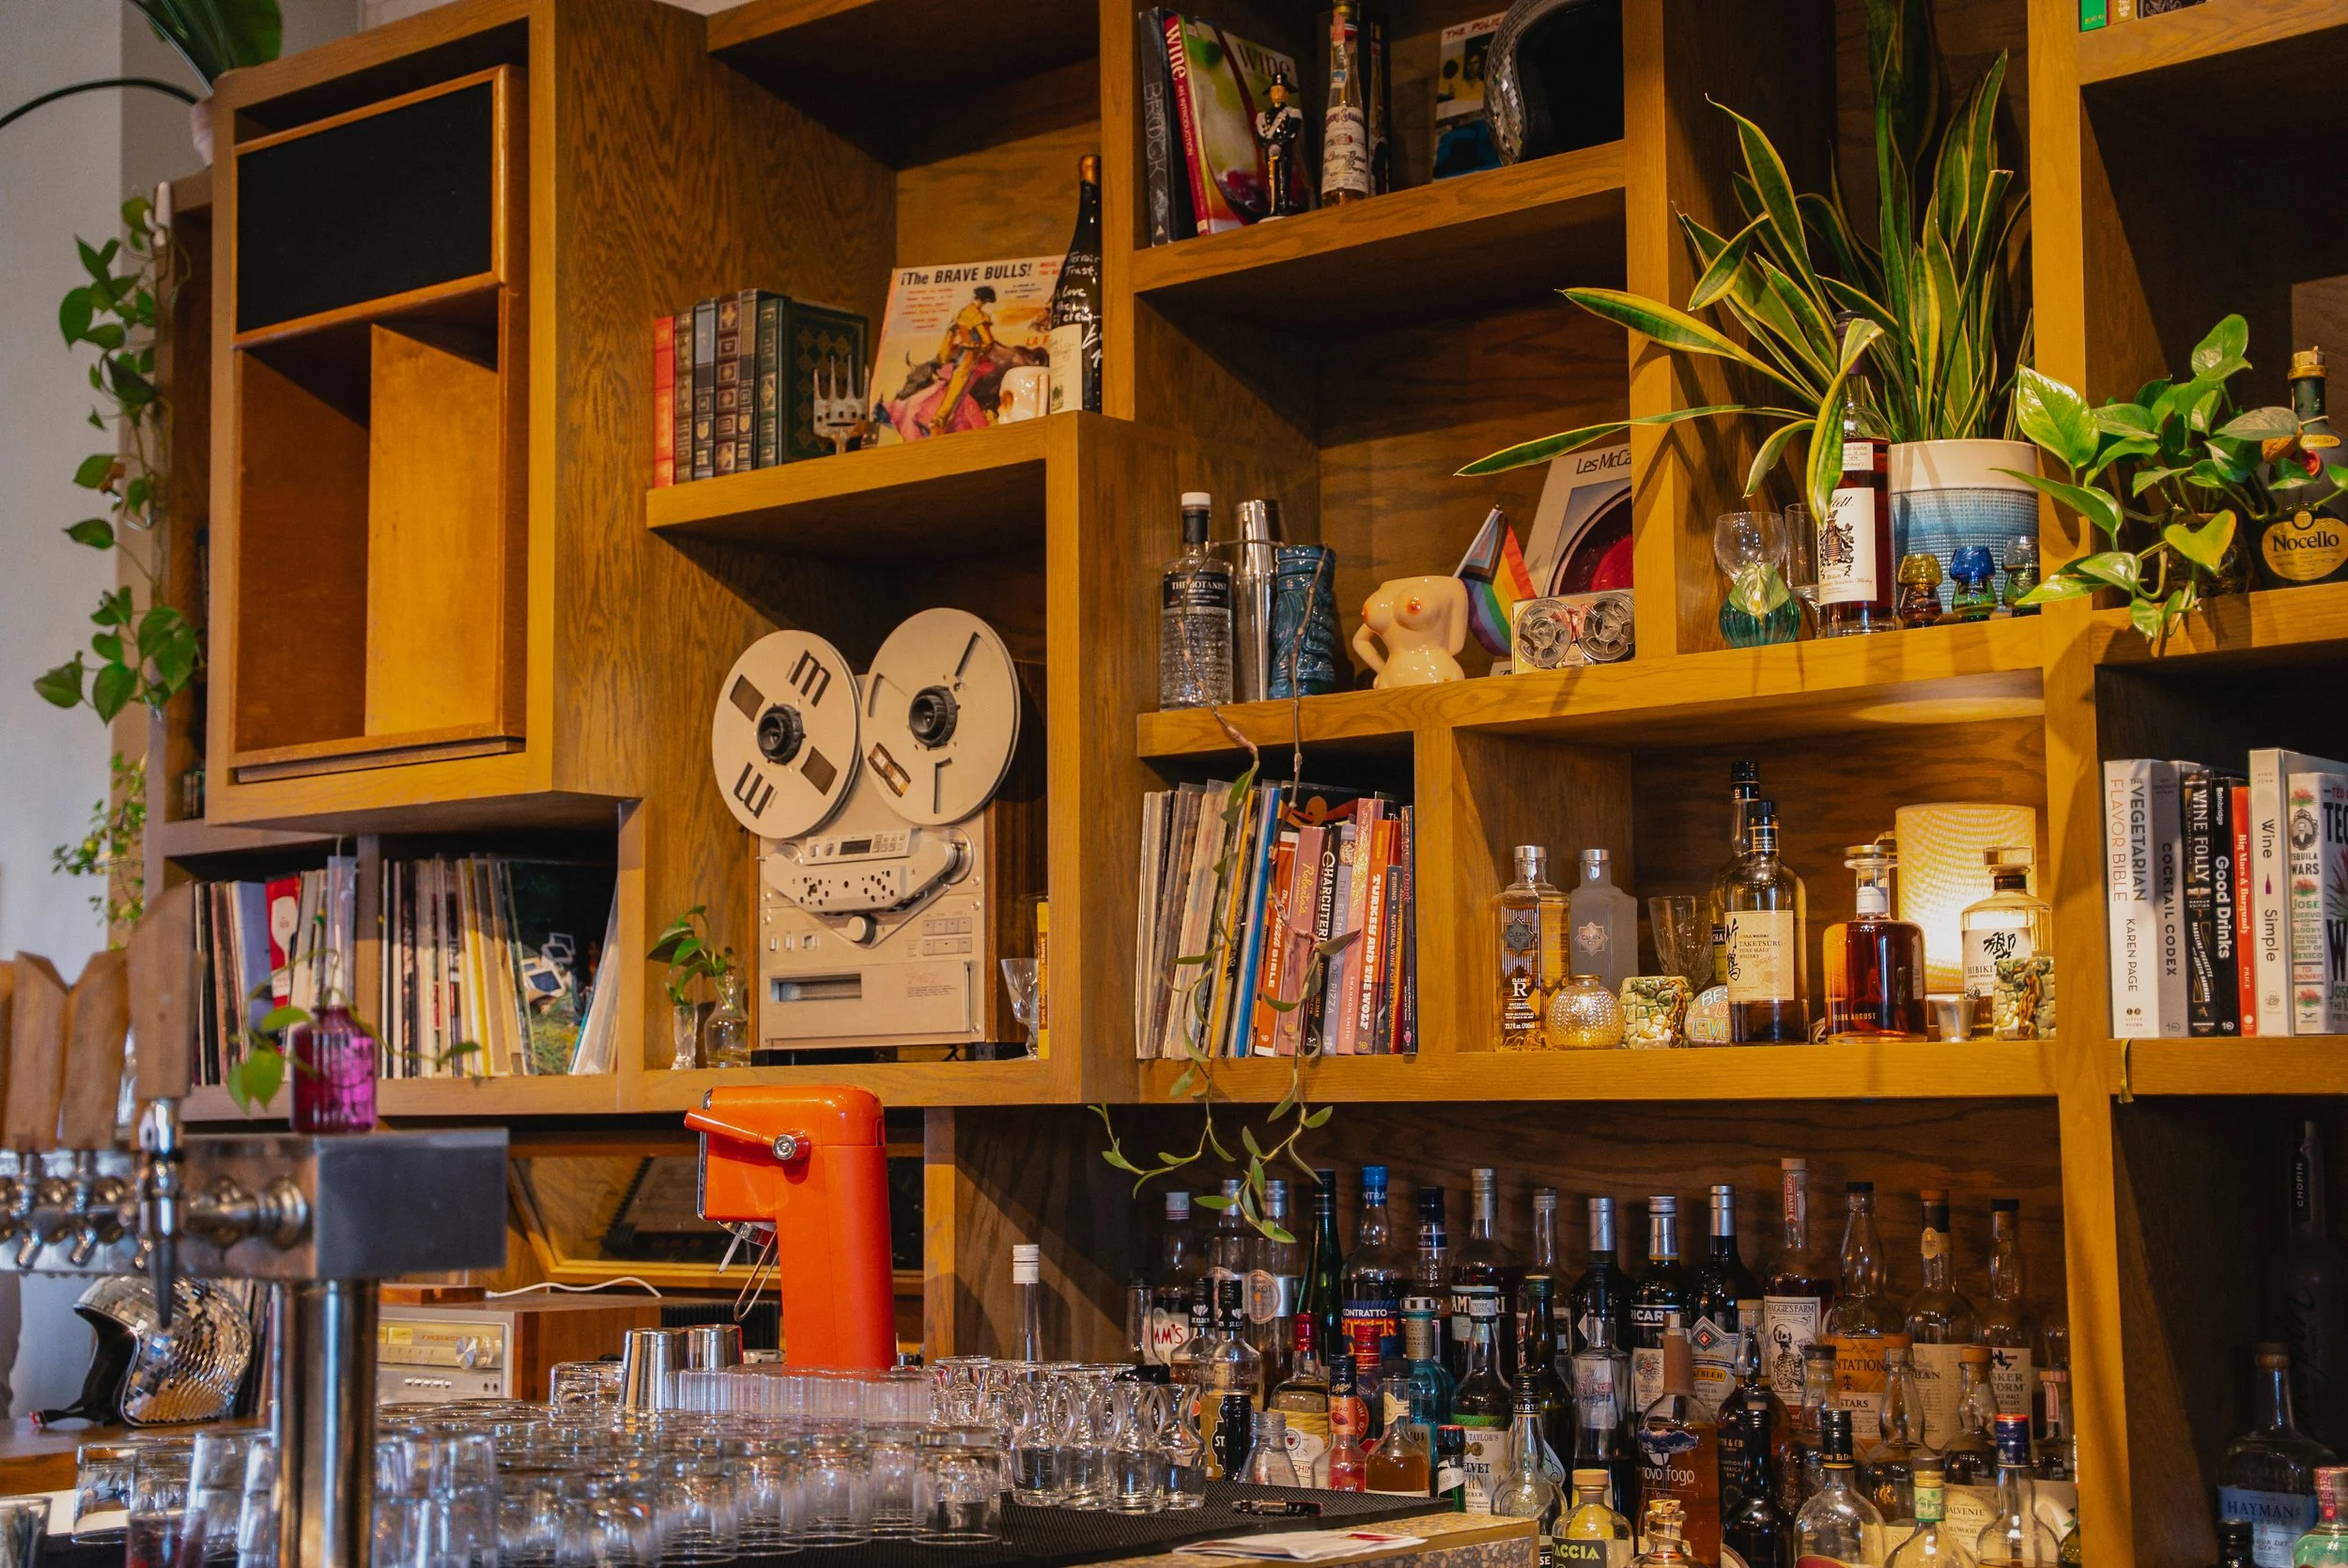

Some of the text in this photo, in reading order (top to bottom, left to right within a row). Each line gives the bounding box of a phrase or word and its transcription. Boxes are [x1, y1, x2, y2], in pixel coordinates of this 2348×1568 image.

[1446, 26, 1466, 38] THE
[1237, 43, 1290, 78] wine
[1166, 23, 1186, 80] wine
[1180, 97, 1193, 156] INTRODUCTION
[935, 267, 980, 284] BRAVE
[986, 262, 1032, 280] BULLS!
[1576, 458, 1599, 474] Les
[2272, 531, 2340, 552] Nocello
[2216, 787, 2224, 826] Bainbridge
[2110, 779, 2127, 901] FLAVOR BIBLE
[2130, 786, 2147, 901] VEGETARIAN
[2193, 790, 2209, 881] WINE FOLLY
[2239, 834, 2248, 851] Big
[2239, 853, 2248, 877] Macs
[2162, 842, 2176, 976] COCKTAIL CODEX
[2215, 855, 2232, 960] Good Drinks
[2262, 819, 2278, 962] Wine Simple
[2239, 891, 2250, 934] Burgundy
[1328, 879, 1346, 1014] THE OF PIZZA
[1360, 873, 1382, 1030] TURKEY AND THE WOLF
[2126, 918, 2139, 992] KAREN PAGE
[1268, 948, 1278, 989] BIBLE
[1512, 982, 1528, 996] R
[1851, 1012, 1876, 1021] AUGUST
[1342, 1309, 1387, 1317] CONTRATTO
[1632, 1310, 1672, 1321] RICAR
[1767, 1303, 1814, 1314] MAGGIE'S FARM
[1666, 1465, 1695, 1486] fogo
